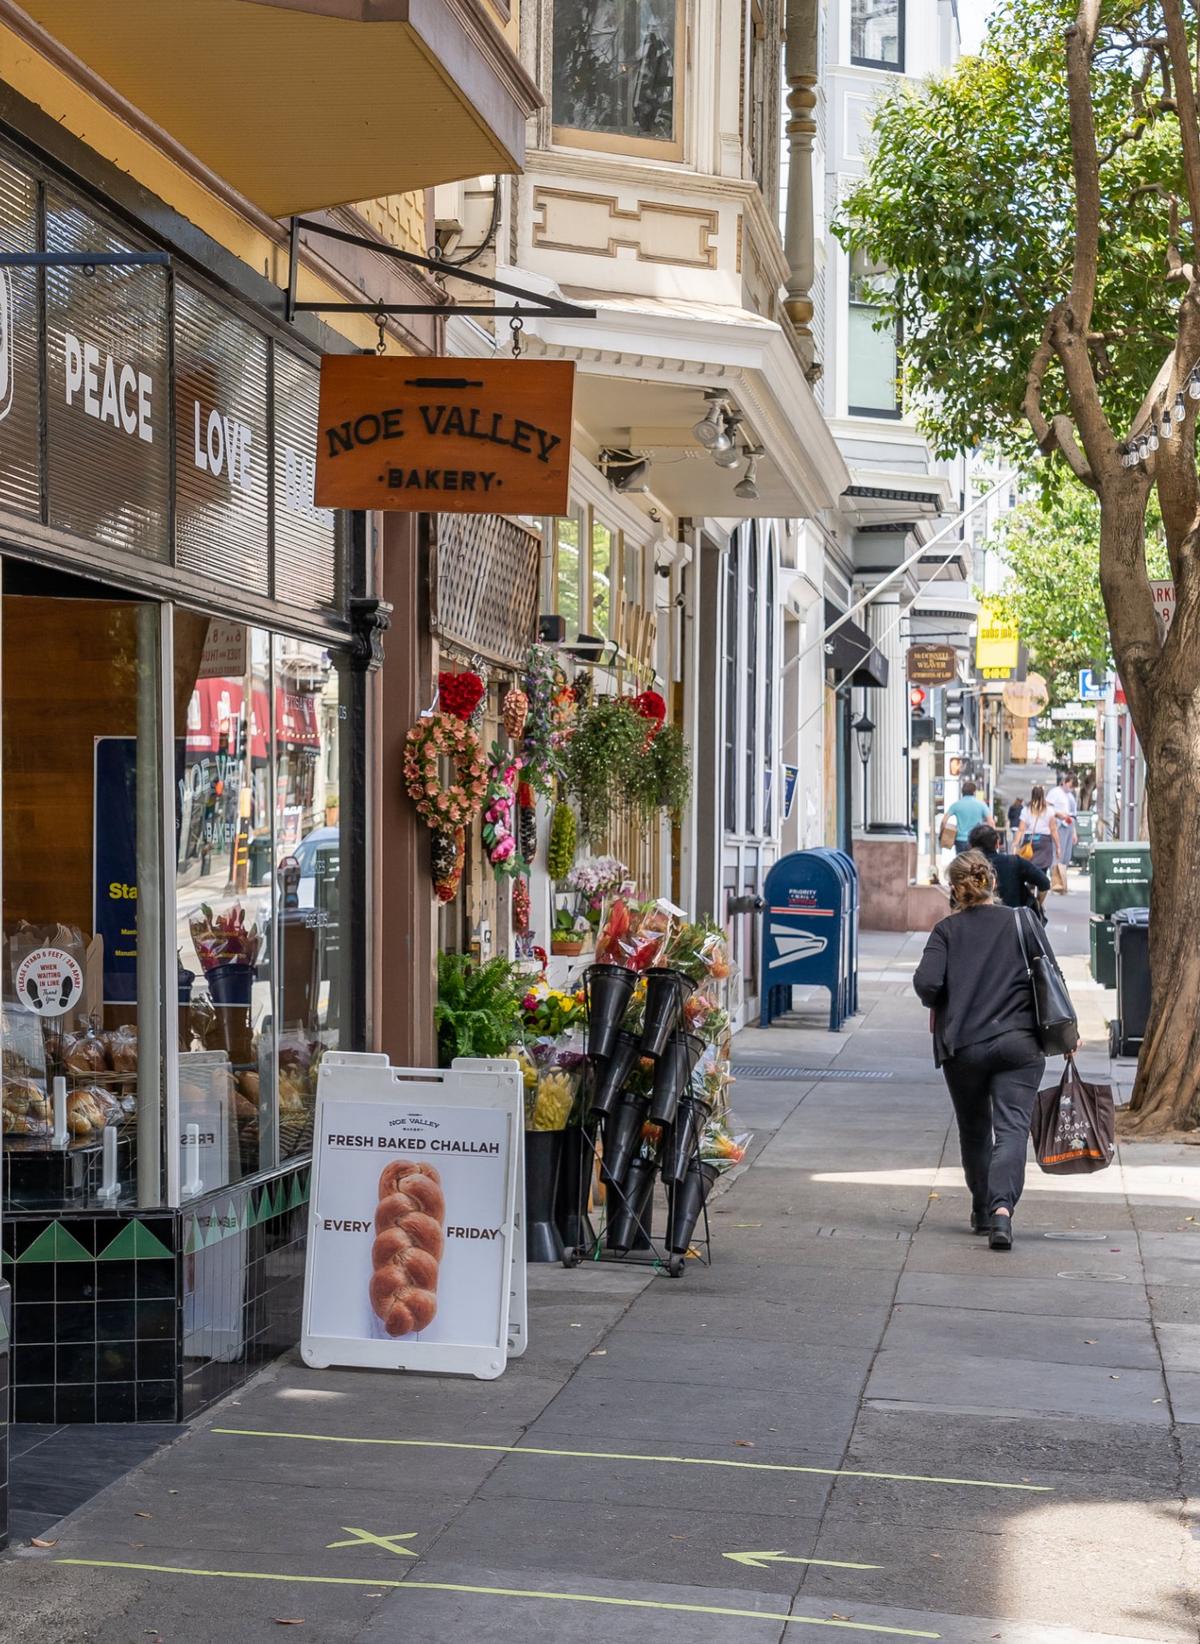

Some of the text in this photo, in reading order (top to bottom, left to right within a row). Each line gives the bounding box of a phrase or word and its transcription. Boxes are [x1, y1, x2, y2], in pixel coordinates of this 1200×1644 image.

[64, 333, 154, 444] PEACE
[193, 400, 254, 493] LOVE
[325, 404, 562, 464] NOE VALLEY
[387, 467, 497, 492] BAKERY
[24, 953, 41, 968] STAND
[48, 951, 63, 959] FEET
[72, 970, 80, 989] APART
[388, 1117, 441, 1129] NOE VALLEY
[327, 1134, 500, 1154] FRESH BAKED CHALLAH
[323, 1219, 501, 1241] EVERY FRIDAY
